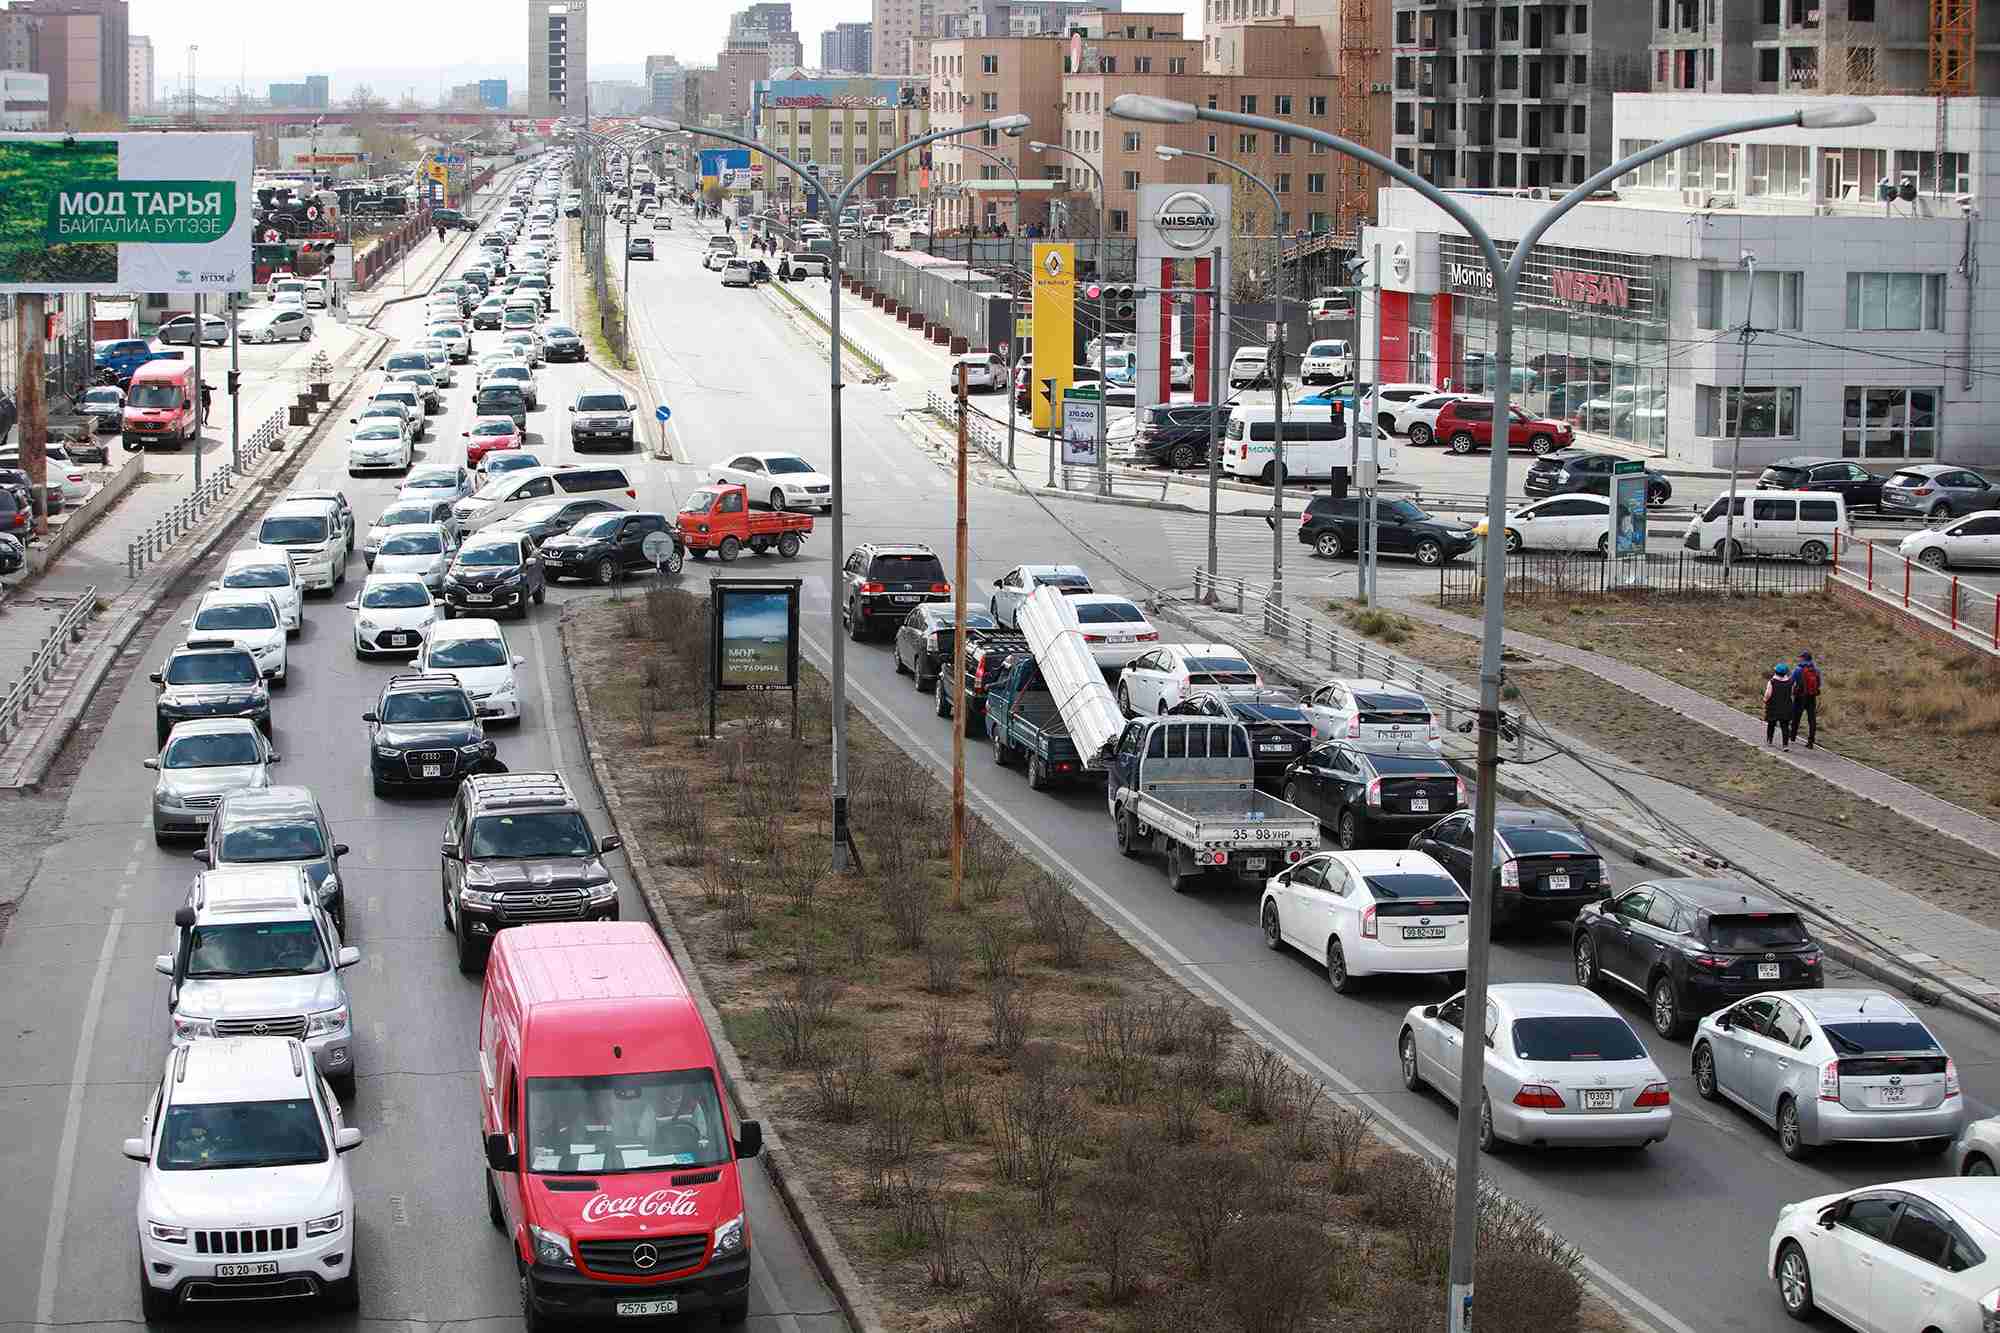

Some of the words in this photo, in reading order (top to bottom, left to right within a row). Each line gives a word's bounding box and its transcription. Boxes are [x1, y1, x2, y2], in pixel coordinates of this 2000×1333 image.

[59, 192, 126, 216] МОД
[132, 192, 221, 215] ТАРЬЯ
[59, 216, 151, 234] БАЙГАЛИА
[1161, 216, 1215, 226] NISSAN
[1451, 263, 1493, 289] Monnis
[1552, 269, 1629, 308] NISSAN
